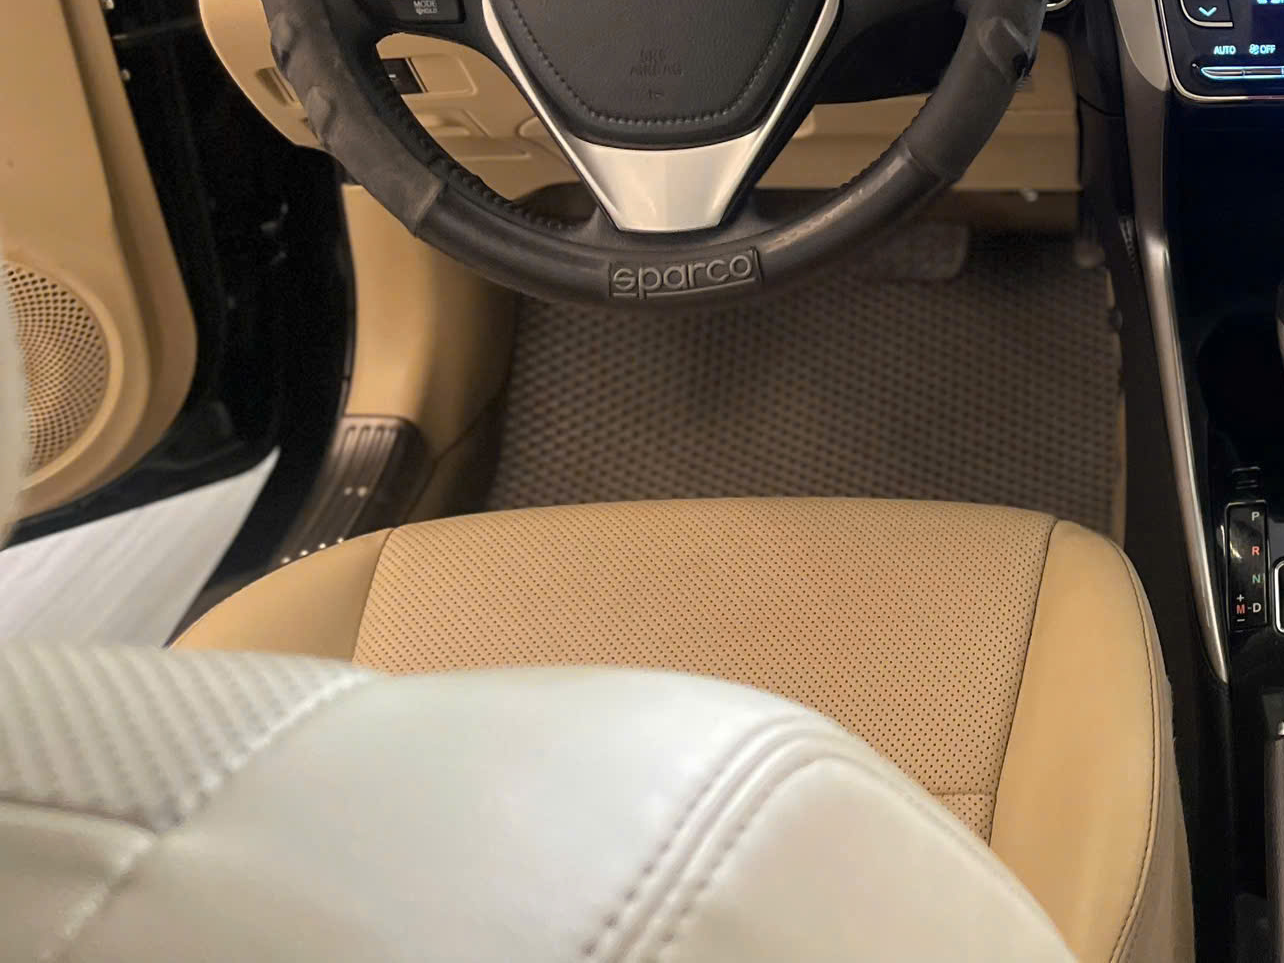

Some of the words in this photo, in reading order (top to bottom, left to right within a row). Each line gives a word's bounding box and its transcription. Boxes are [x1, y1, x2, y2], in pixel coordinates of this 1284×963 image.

[413, 0, 437, 7] MODE
[1213, 45, 1237, 55] AUTO
[1260, 44, 1277, 54] OFF
[613, 254, 753, 300] sparco
[1251, 511, 1260, 521] P
[1251, 545, 1260, 556] R
[1252, 574, 1261, 584] N
